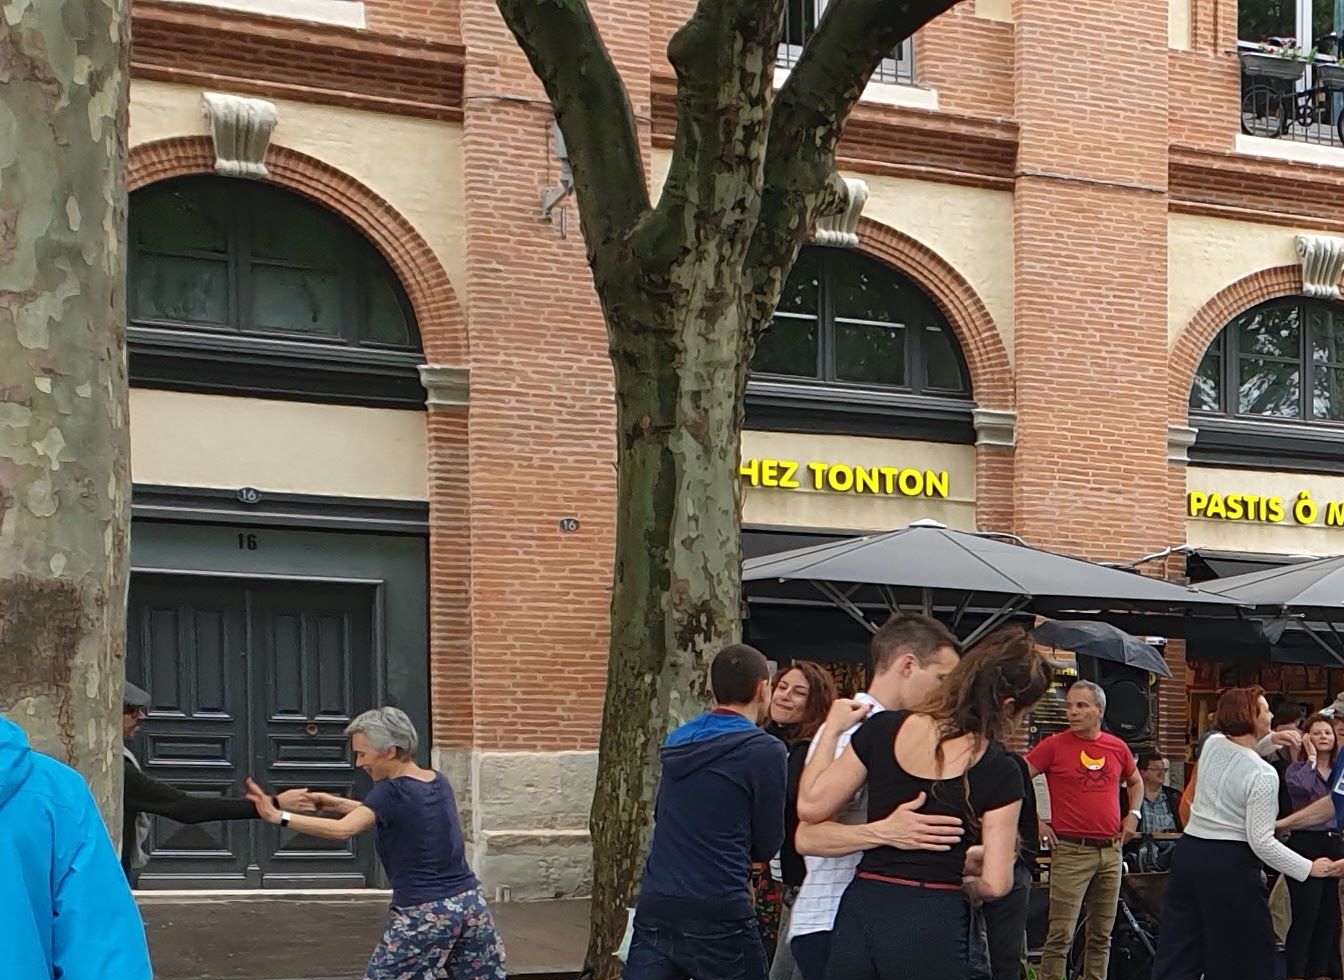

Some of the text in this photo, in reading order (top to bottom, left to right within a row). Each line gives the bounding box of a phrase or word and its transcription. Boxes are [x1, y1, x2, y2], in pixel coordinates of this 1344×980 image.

[739, 458, 949, 498] HEZ TONTON
[241, 488, 257, 501] 16
[1189, 491, 1285, 522] PASTIS
[1294, 490, 1318, 525] Ô
[563, 519, 577, 531] 16
[238, 532, 257, 551] 16
